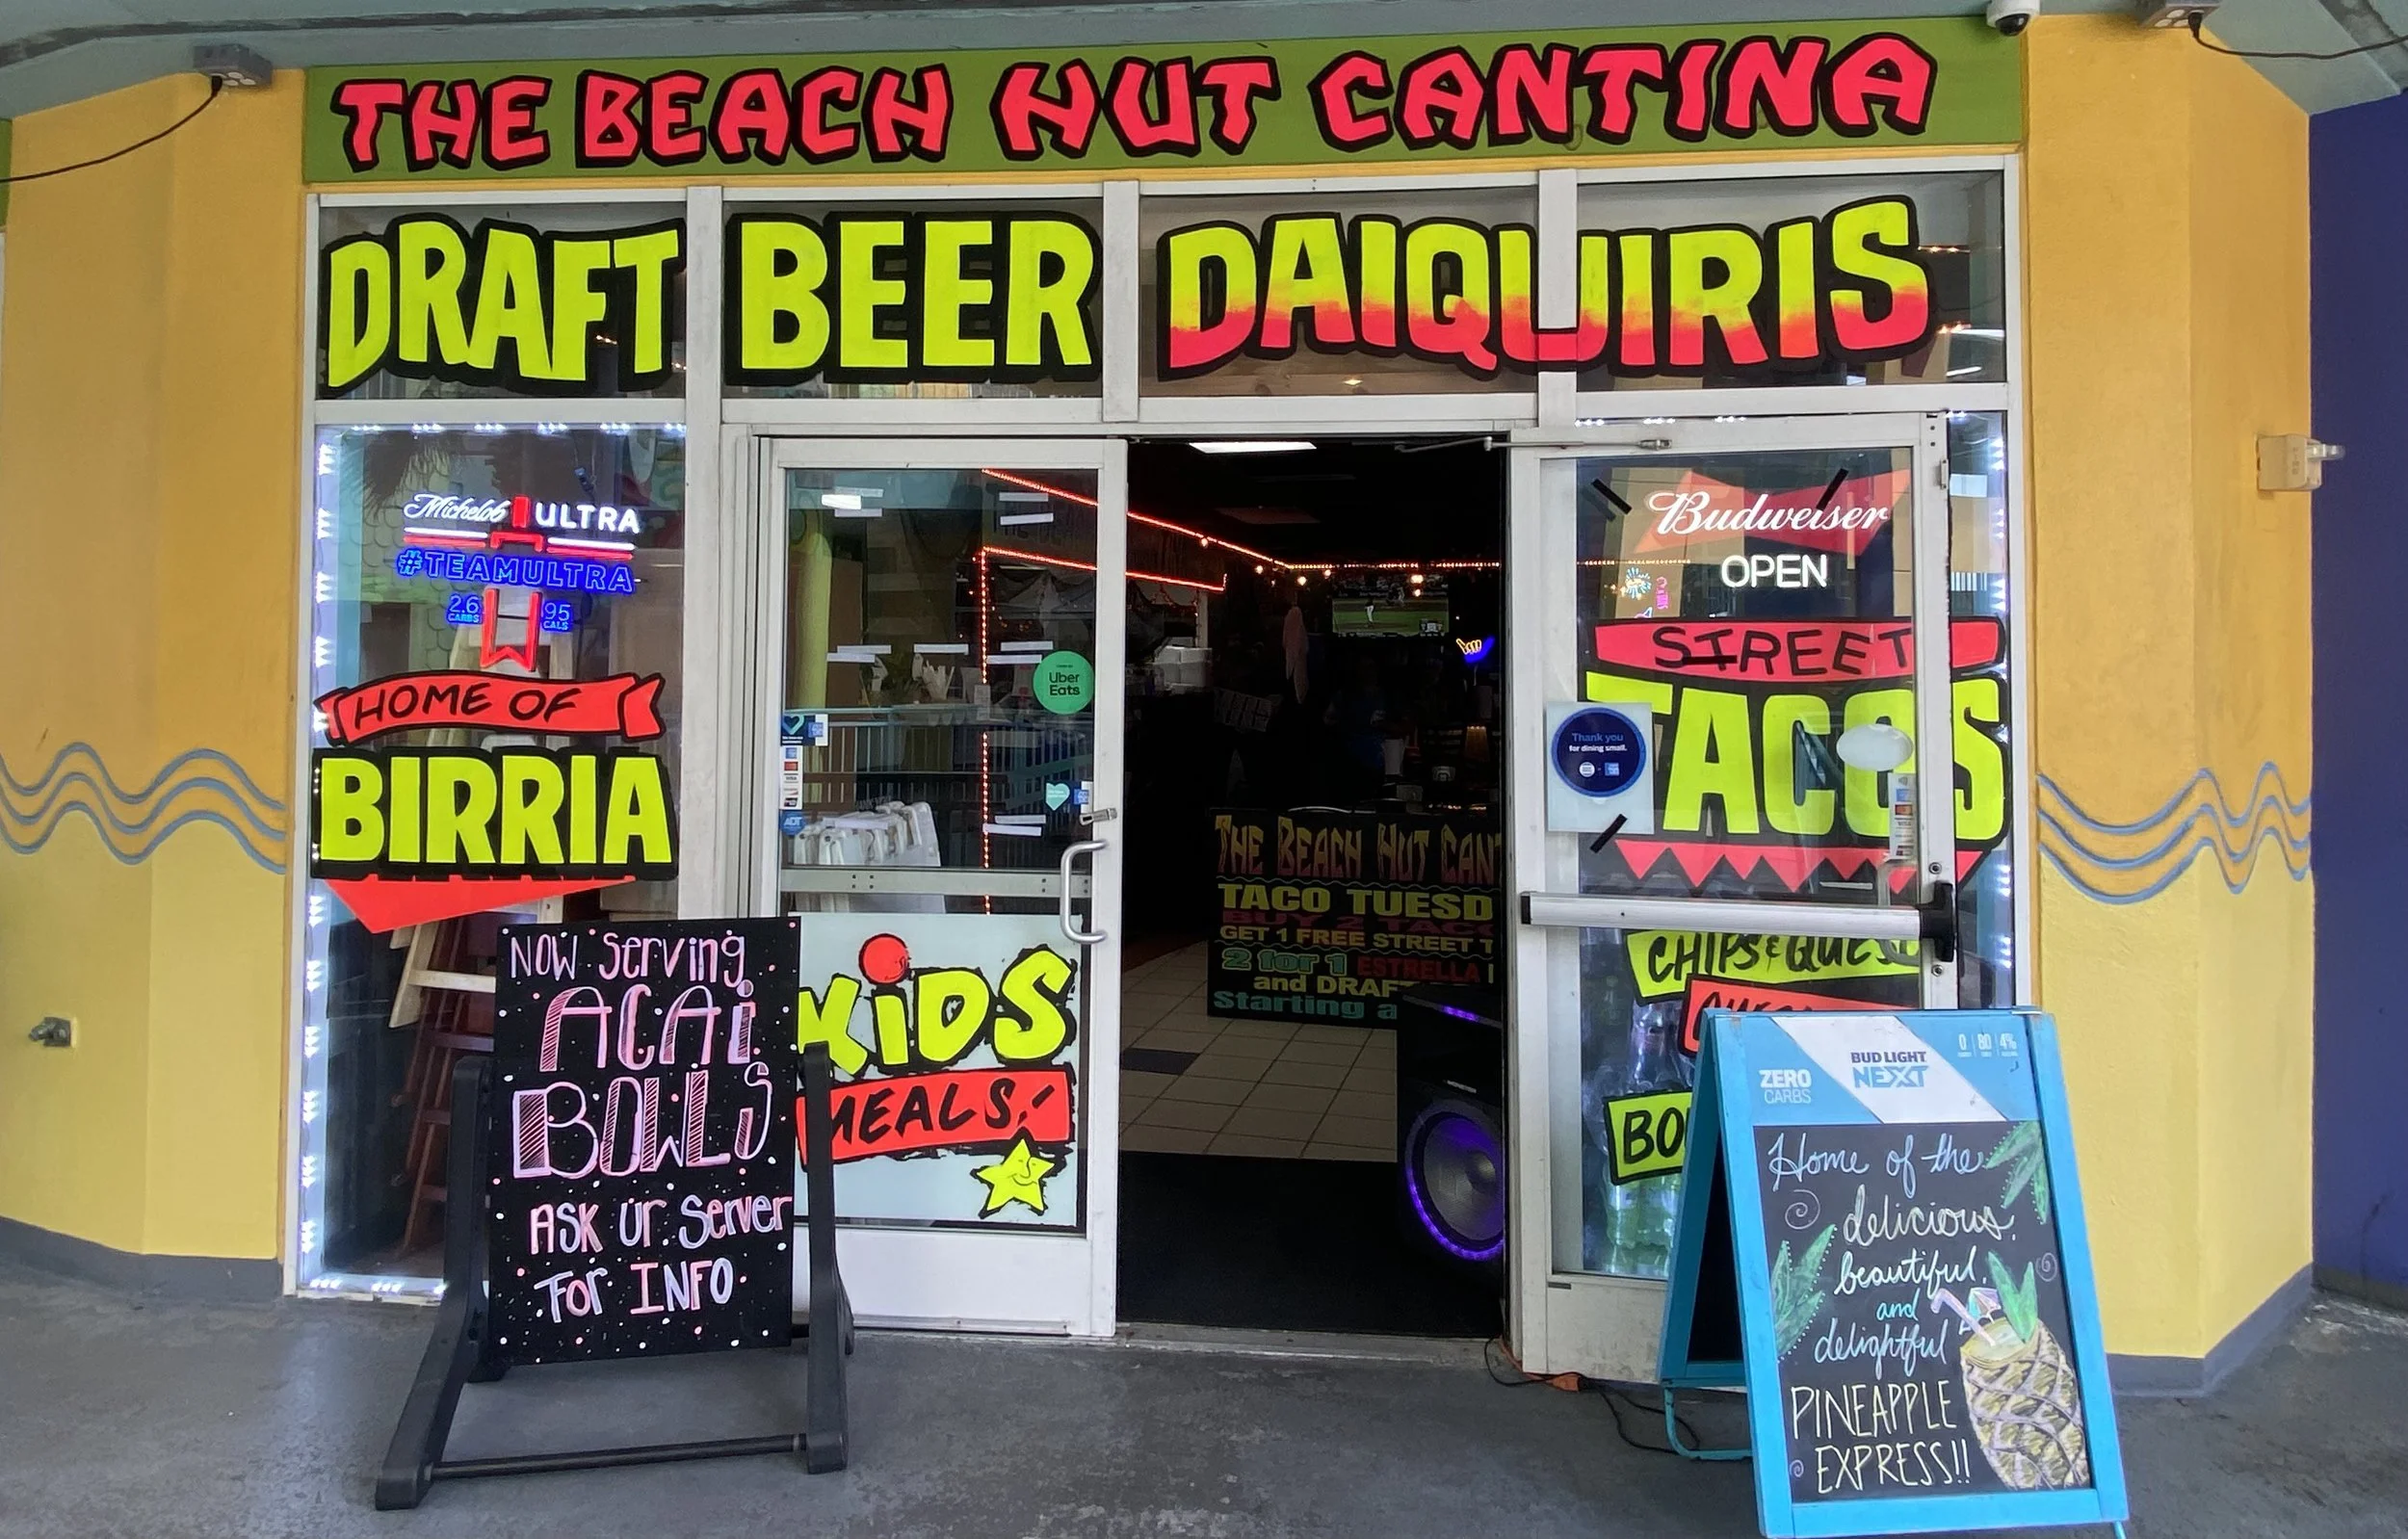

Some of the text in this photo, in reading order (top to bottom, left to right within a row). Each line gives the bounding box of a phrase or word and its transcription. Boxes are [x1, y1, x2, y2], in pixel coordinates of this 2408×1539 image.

[331, 33, 1937, 170] THE BEACH HUT CANTINA
[322, 196, 1936, 396] DRAFT BEER DAIQUIRIS
[403, 492, 641, 535] Michelob ULTRA
[1646, 490, 1891, 535] Budweiser
[397, 549, 634, 593] #TEAMULTRA
[1721, 553, 1828, 588] OPEN
[447, 613, 480, 623] CARBS
[449, 594, 480, 613] 2.6
[543, 602, 571, 621] 95
[1651, 624, 1914, 676] STREET
[1049, 671, 1080, 683] Uber
[1049, 685, 1081, 695] Eats
[354, 681, 583, 731] HOME OF
[1571, 733, 1624, 743] Thank you
[312, 748, 677, 879] BIRRIA
[1217, 883, 1331, 914] TACO
[1222, 910, 1323, 926] BUY
[1337, 916, 1366, 931] 2
[1219, 926, 1269, 941] GET
[1276, 927, 1288, 942] 1
[1296, 929, 1366, 948] FREE
[1373, 934, 1475, 952] STREET
[510, 934, 578, 980] NOW
[1221, 948, 1252, 972] 2
[1257, 949, 1322, 975] for
[1324, 952, 1348, 977] 1
[1357, 956, 1480, 983] ESTRELLA
[1253, 975, 1307, 993] and
[1213, 990, 1365, 1020] Starting
[1851, 1051, 1927, 1063] BUD LIGHT
[2000, 1032, 2018, 1051] 4%
[1759, 1069, 1812, 1088] ZERO
[1852, 1065, 1928, 1088] NEXT
[1764, 1088, 1812, 1105] CARBS
[513, 1061, 773, 1179] BOWLS
[1623, 1107, 1691, 1165] BO
[1767, 1132, 1986, 1198] Home of the
[630, 1257, 735, 1316] INFO
[1876, 1289, 1921, 1322] and
[1814, 1317, 1948, 1380] delightful
[1791, 1380, 1957, 1440] PINEAPPLE
[1817, 1438, 1972, 1495] EXPRESS!!
